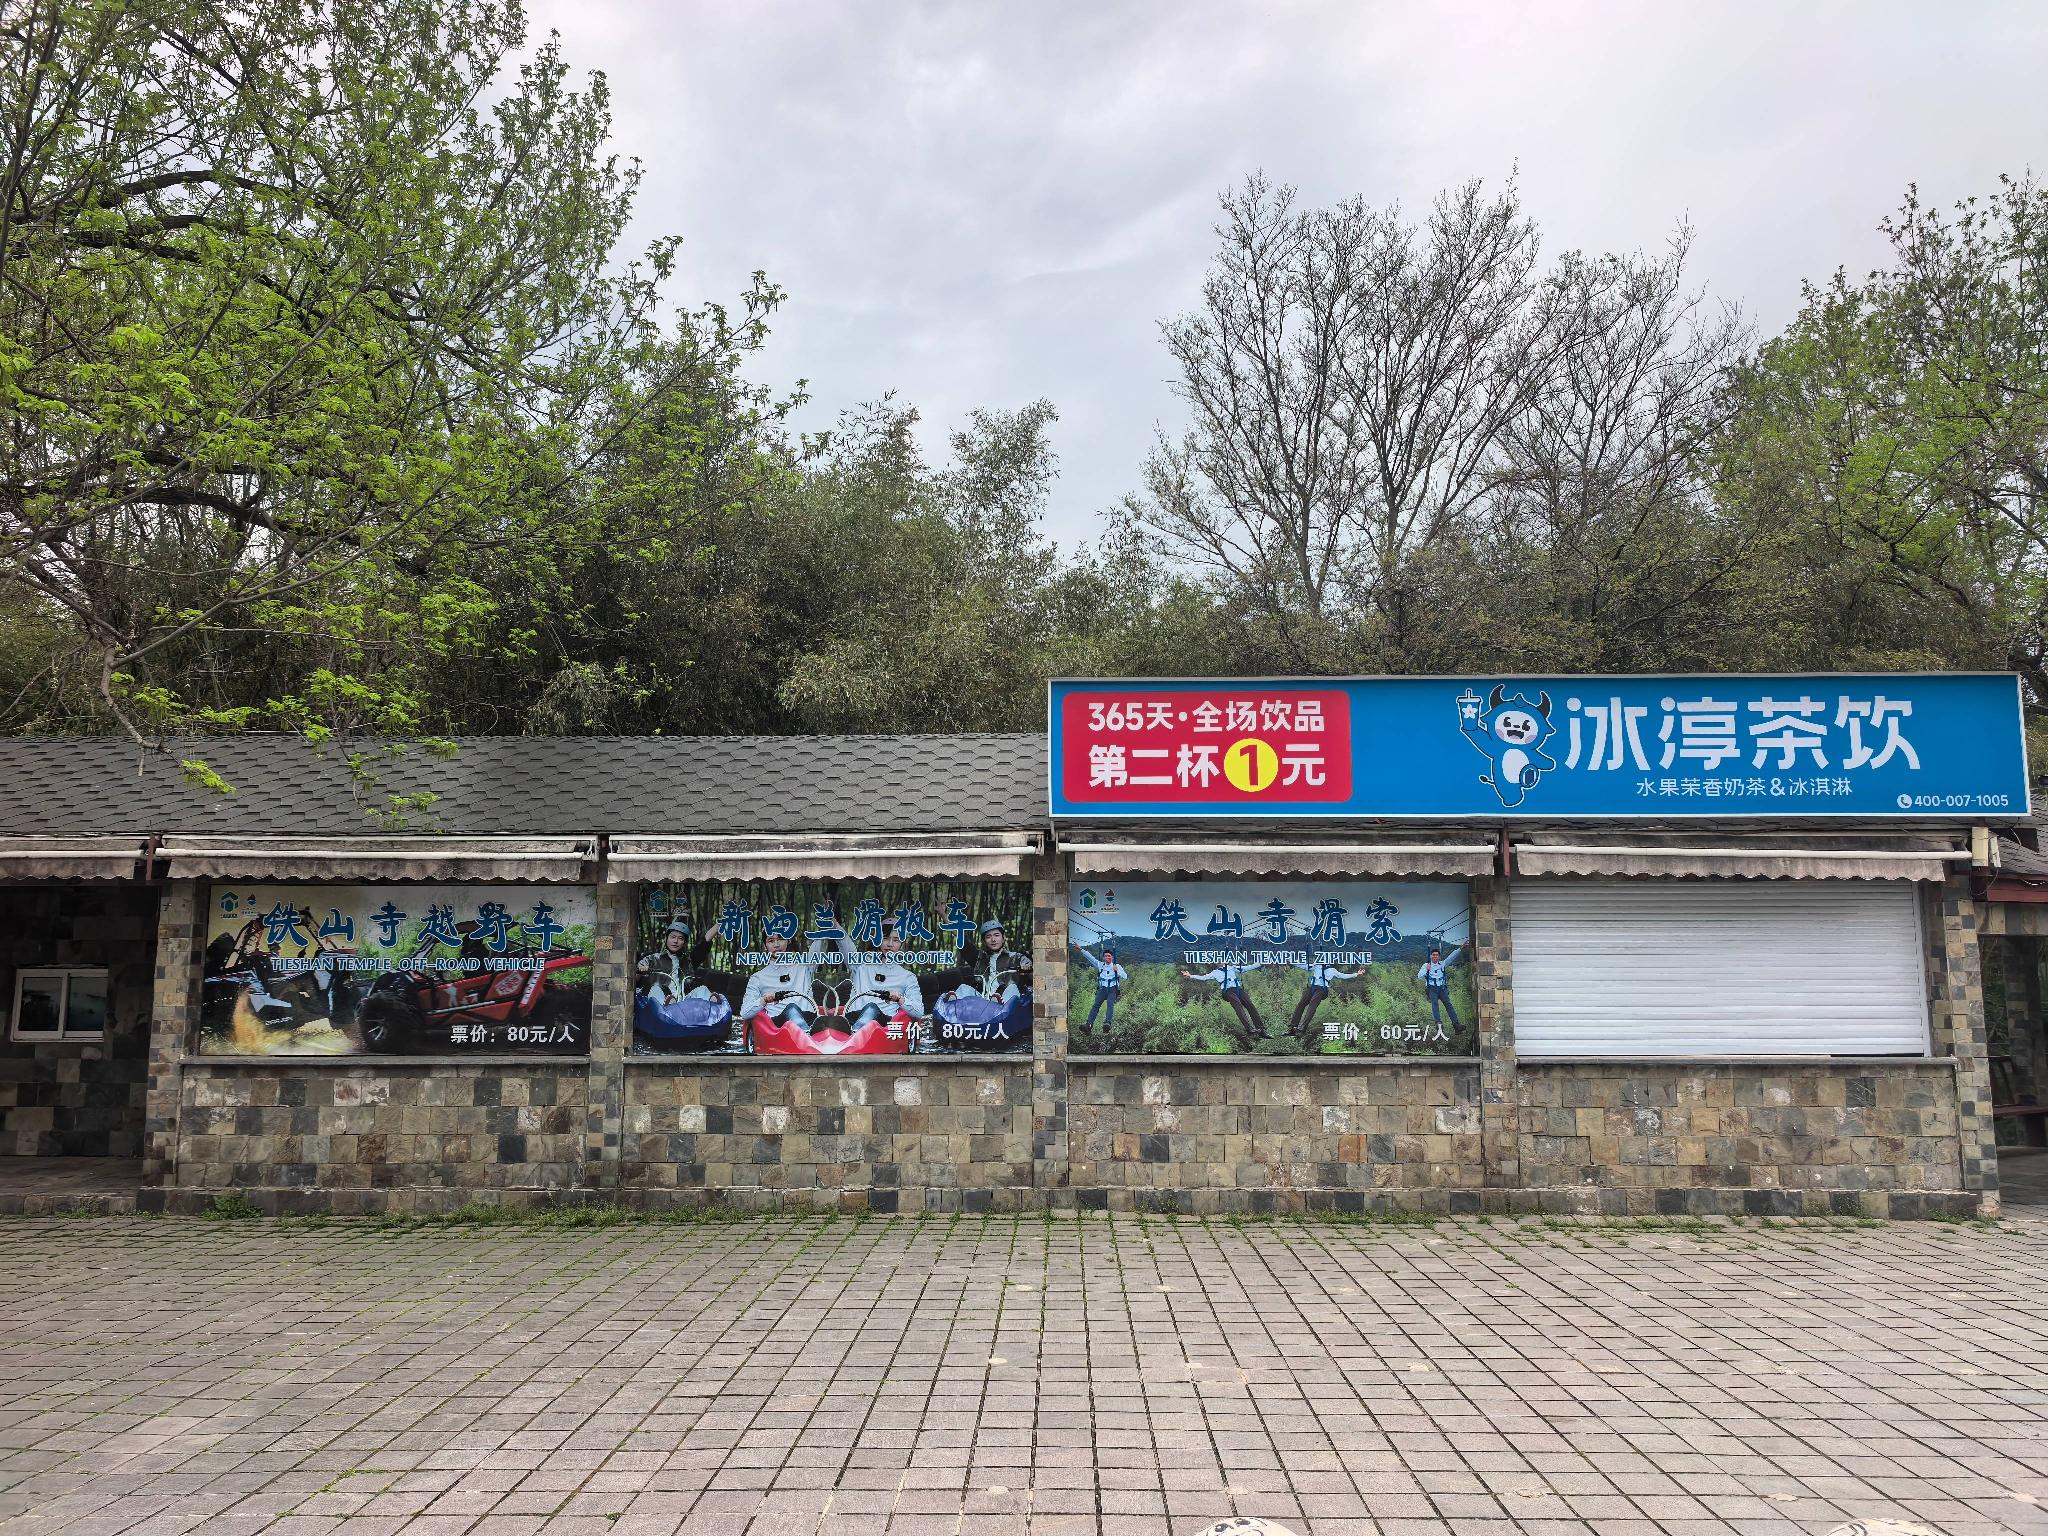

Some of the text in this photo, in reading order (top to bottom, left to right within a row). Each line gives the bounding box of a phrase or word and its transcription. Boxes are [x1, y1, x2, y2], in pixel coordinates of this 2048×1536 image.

[1087, 700, 1325, 732] 365天·全场饮品
[1564, 696, 1921, 770] 冰淳茶饮
[1914, 794, 2009, 807] 400-007-1005
[717, 898, 977, 949] 新西兰滑板车
[271, 957, 334, 971] TIESHAN
[337, 957, 391, 971] TEMPLE
[484, 957, 545, 971] VEHICLE
[735, 950, 954, 965] NEW ZEALAND KICK SCOOTER
[1184, 950, 1372, 965] TIESHAN TEMPLE ZIPLINE
